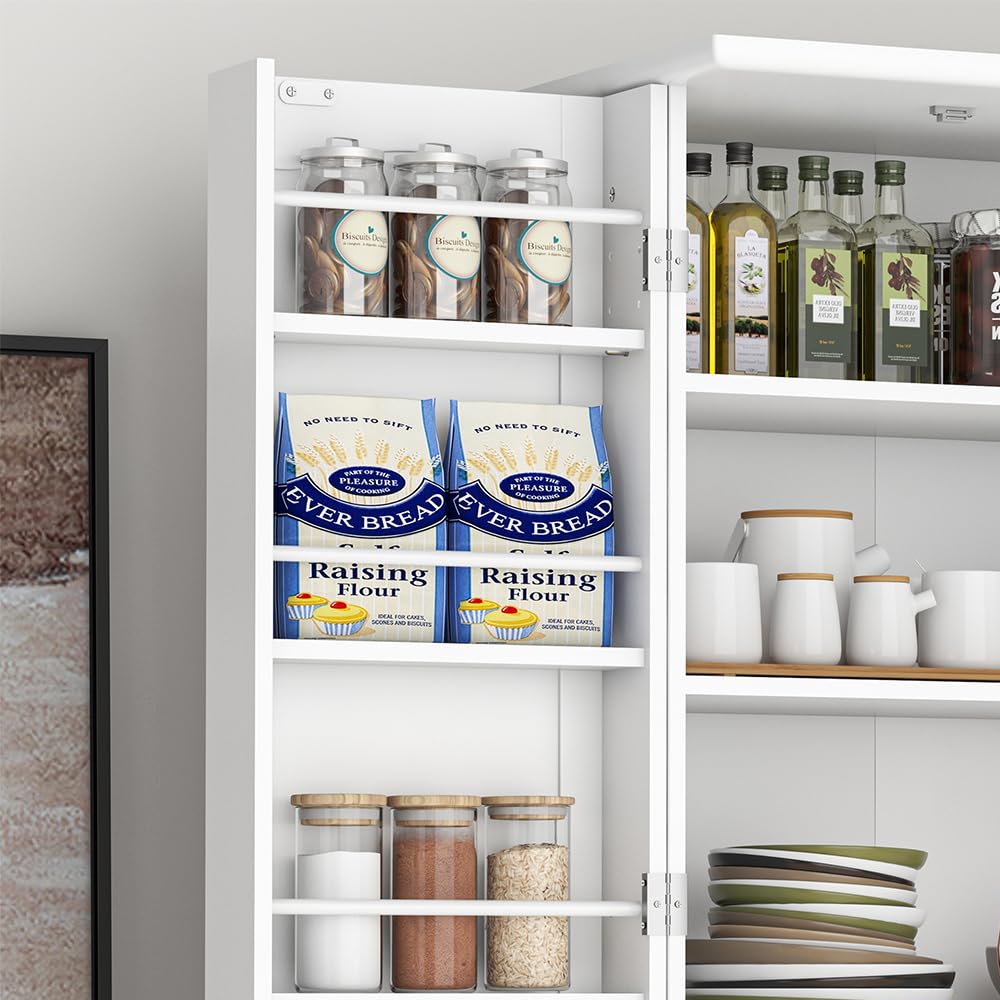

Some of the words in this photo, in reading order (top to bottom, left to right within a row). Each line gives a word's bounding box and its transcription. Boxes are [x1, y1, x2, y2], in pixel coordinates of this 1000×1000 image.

[341, 232, 372, 241] Biscuits
[435, 237, 464, 246] Biscuits
[527, 242, 556, 251] Biscuits
[304, 418, 320, 427] NO
[383, 420, 413, 431] SIFT
[474, 425, 491, 434] NO
[552, 426, 582, 438] SIFT
[375, 470, 391, 478] THE
[339, 477, 399, 487] PLEASURE
[545, 477, 560, 485] THE
[355, 487, 390, 495] COOKING
[510, 483, 568, 493] PLEASURE
[525, 493, 560, 501] COOKING
[286, 486, 354, 529] EVER
[361, 493, 445, 530] BREAD
[458, 492, 525, 534] EVER
[531, 499, 613, 536] BREAD
[308, 562, 428, 587] Raising
[480, 568, 597, 592] Raising
[337, 583, 400, 597] Flour
[508, 588, 570, 602] Flour
